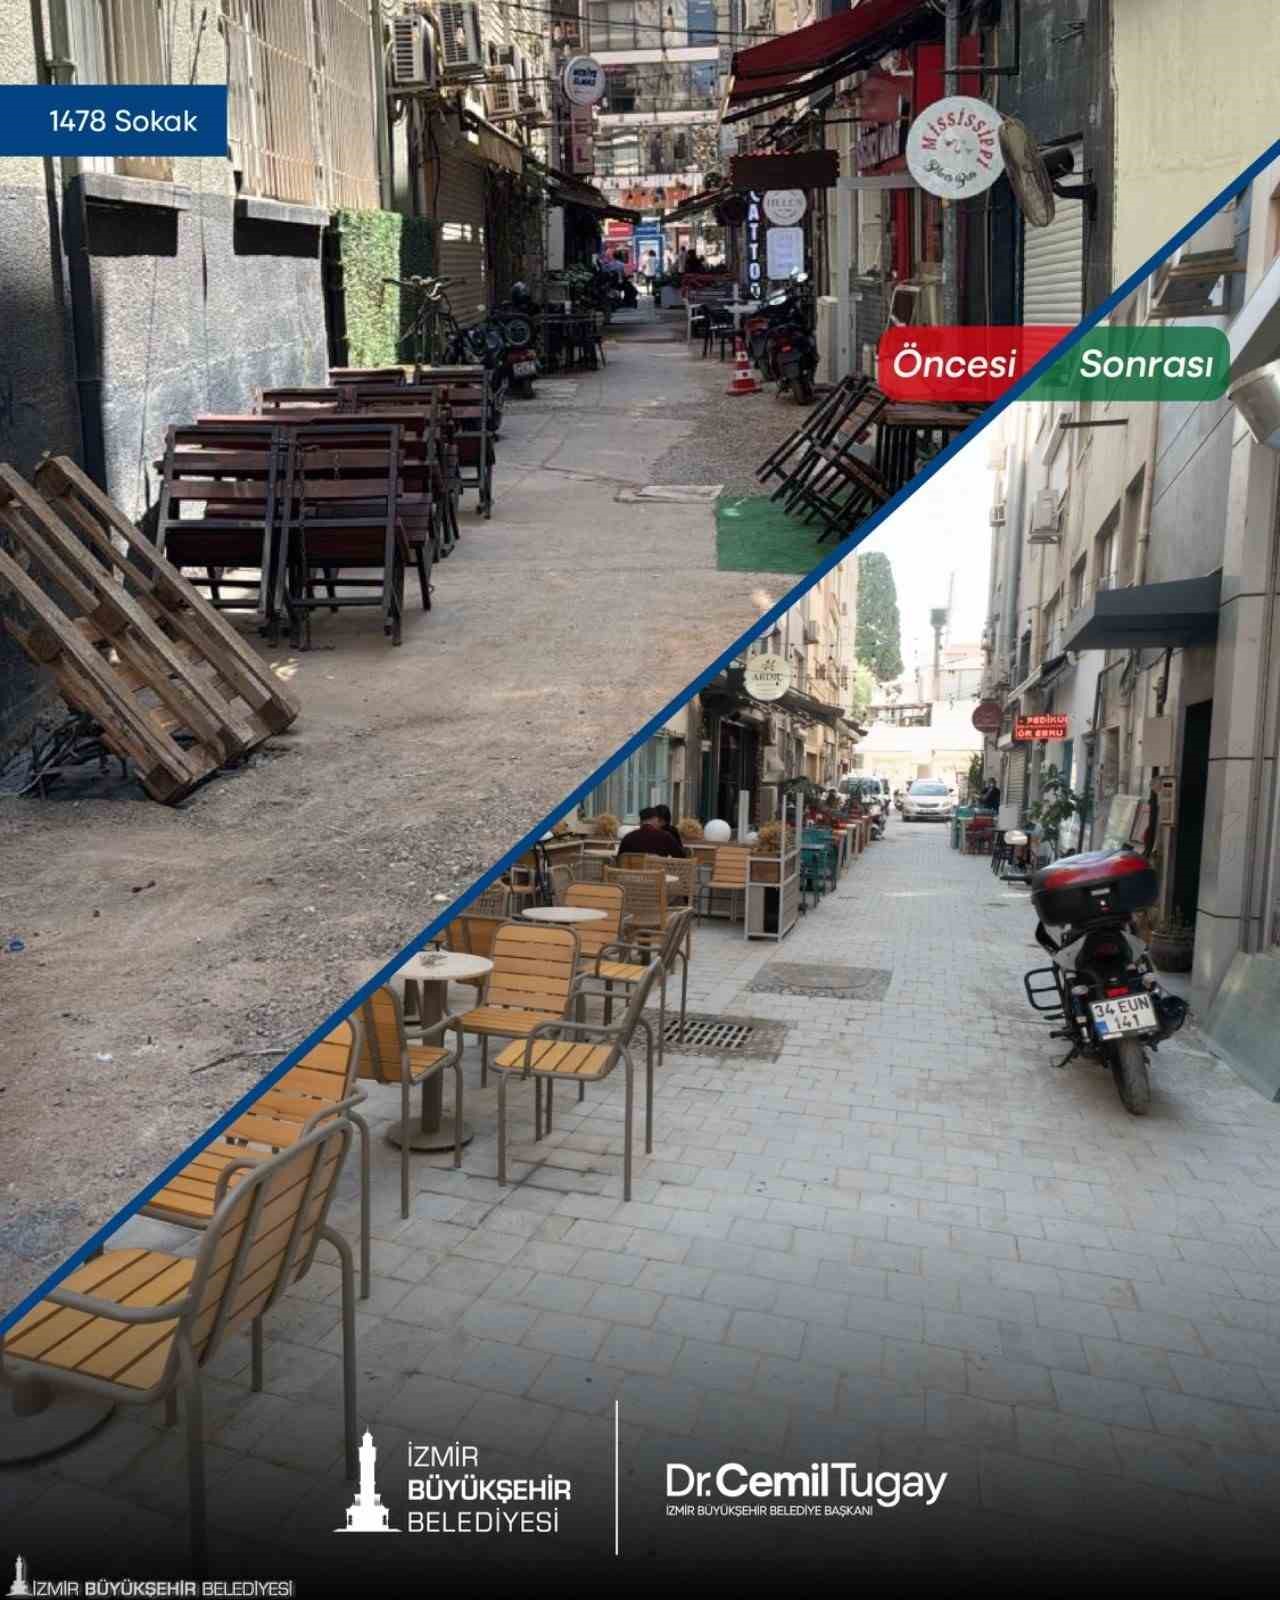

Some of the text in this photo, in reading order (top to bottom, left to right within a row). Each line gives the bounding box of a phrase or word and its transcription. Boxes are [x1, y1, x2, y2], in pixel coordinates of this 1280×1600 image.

[1094, 997, 1150, 1018] 34 EUN
[1114, 1013, 1140, 1030] 141
